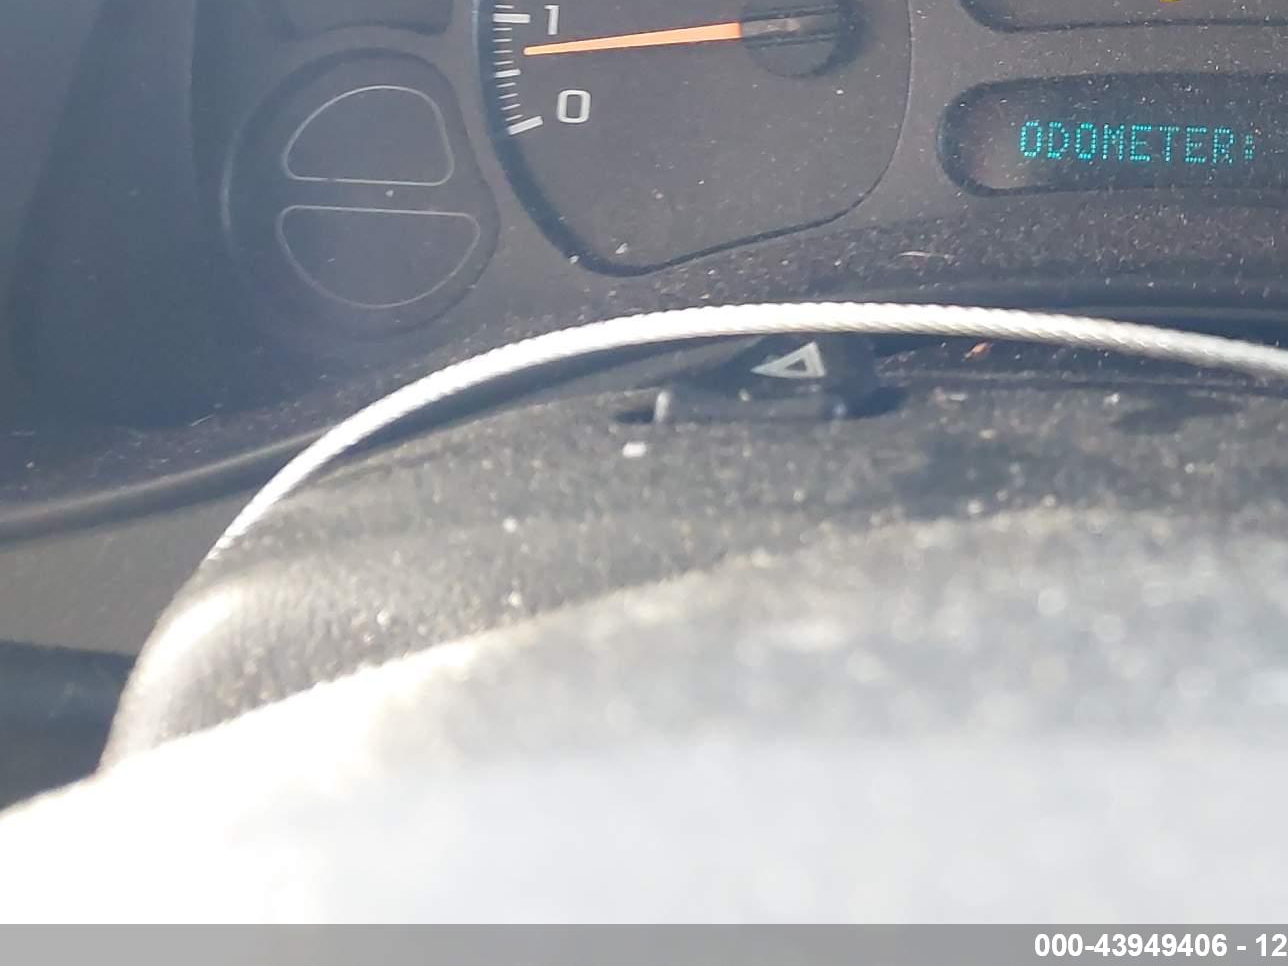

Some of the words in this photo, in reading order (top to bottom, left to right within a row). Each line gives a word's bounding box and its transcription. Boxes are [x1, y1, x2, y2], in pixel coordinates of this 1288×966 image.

[544, 5, 560, 35] 1
[556, 89, 591, 124] 0
[1018, 120, 1255, 165] ODOMETER:
